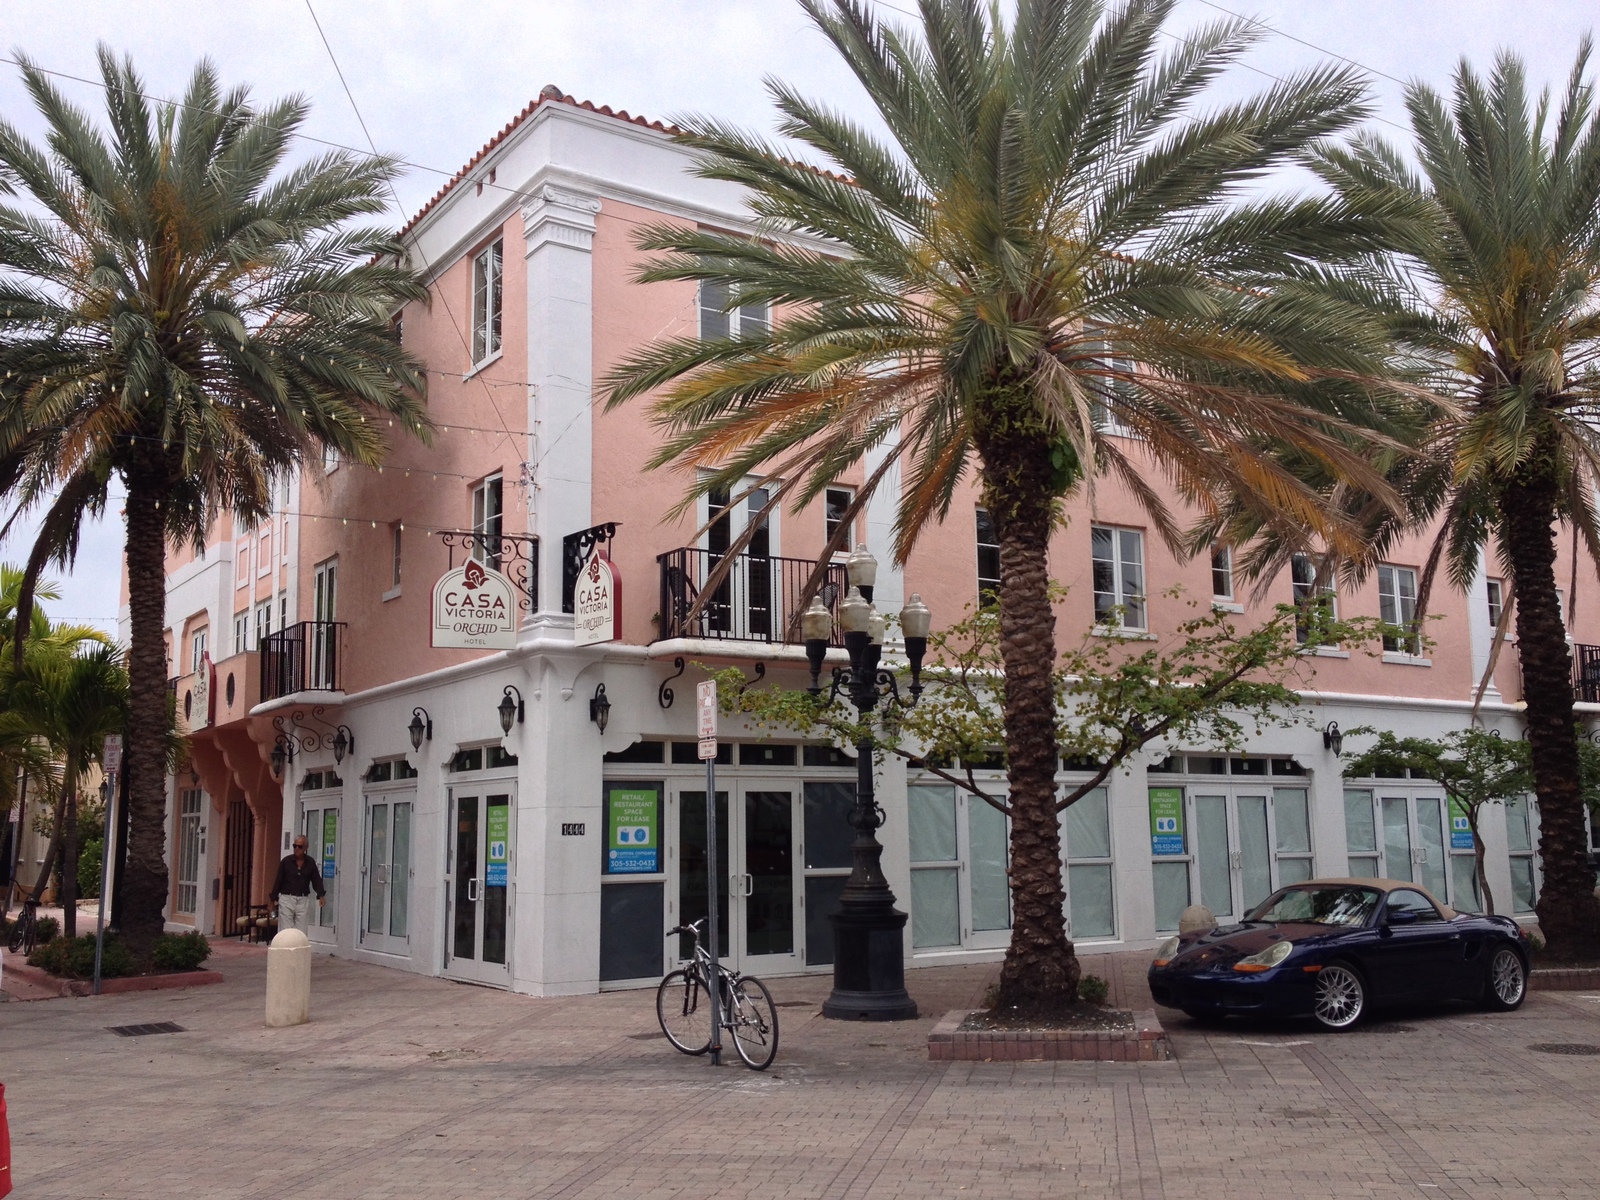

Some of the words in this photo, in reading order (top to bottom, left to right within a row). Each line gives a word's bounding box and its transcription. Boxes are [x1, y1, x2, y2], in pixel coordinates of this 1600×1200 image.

[445, 592, 506, 609] CASA
[579, 586, 608, 605] CASA
[445, 608, 506, 620] VICTORIA
[579, 602, 608, 615] VICTORIA
[453, 622, 498, 636] ORCHID
[582, 615, 605, 631] ORCHID
[703, 687, 711, 697] NO
[562, 823, 585, 836] 1444
